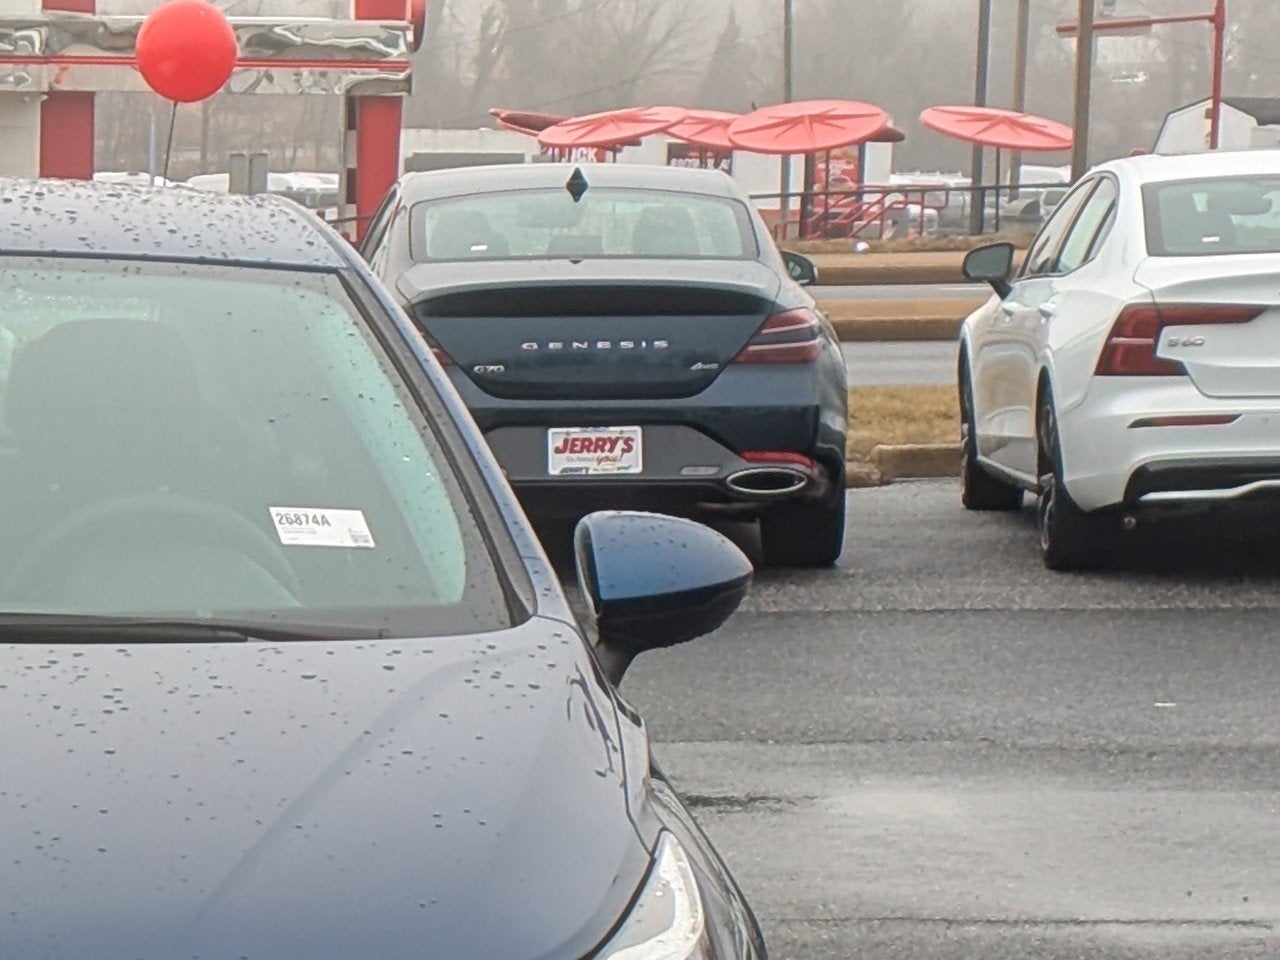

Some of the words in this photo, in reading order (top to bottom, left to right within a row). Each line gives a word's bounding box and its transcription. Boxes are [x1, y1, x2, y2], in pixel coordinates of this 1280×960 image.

[521, 340, 668, 349] GENESIS
[554, 436, 635, 454] JERRY'S
[275, 512, 331, 527] 26874A
